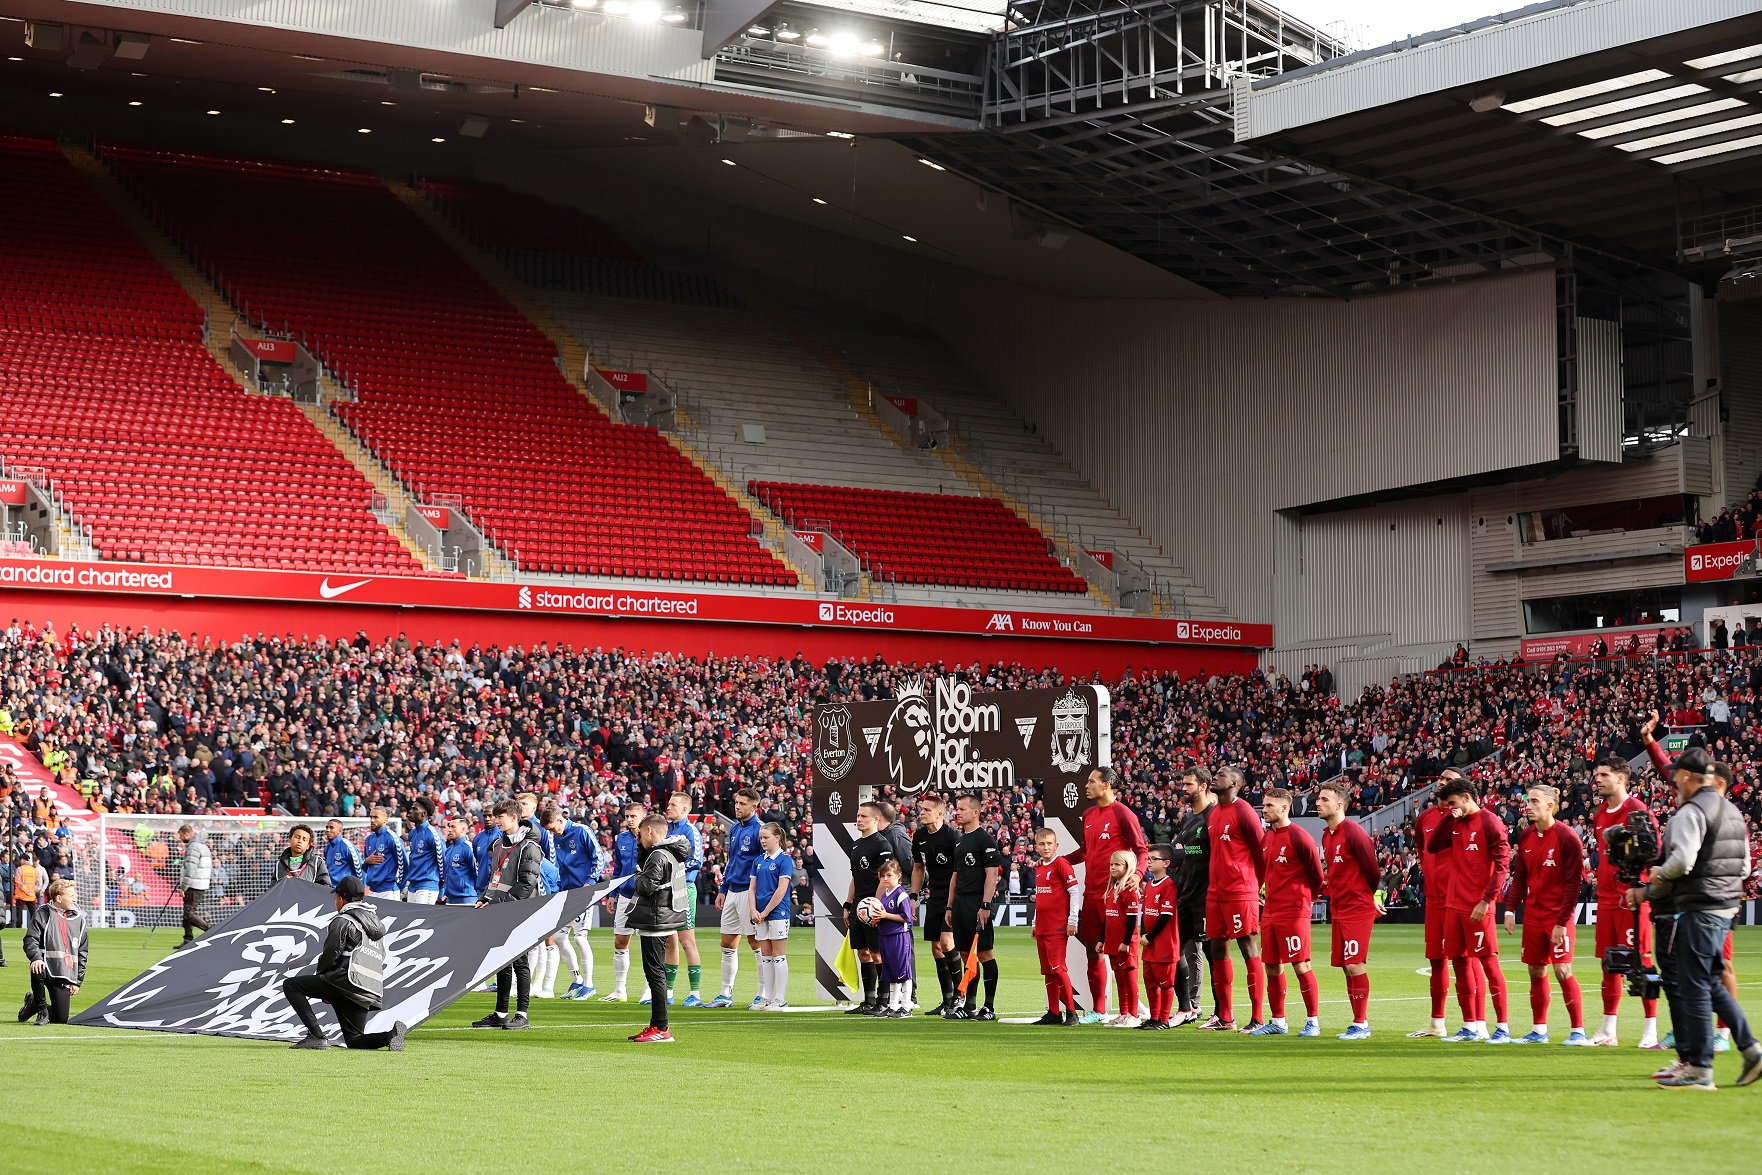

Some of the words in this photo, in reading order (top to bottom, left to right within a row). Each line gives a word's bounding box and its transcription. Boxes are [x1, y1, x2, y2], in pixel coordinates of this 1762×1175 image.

[257, 341, 275, 351] AU3
[612, 373, 628, 382] AU2
[421, 509, 441, 518] AM3
[77, 566, 173, 588] chartered
[536, 590, 613, 610] standard
[617, 594, 697, 614] chartered
[836, 605, 894, 625] Expedia
[985, 613, 1014, 631] AXA
[1021, 618, 1051, 631] Know
[1053, 619, 1072, 632] You
[1073, 620, 1092, 633] Can
[1192, 624, 1241, 641] Expedia
[936, 677, 970, 710] No
[936, 704, 999, 734] room
[1057, 721, 1083, 729] LIVERPOOL
[823, 748, 846, 759] Everton
[936, 732, 970, 764] for
[937, 751, 1013, 789] racism
[1233, 913, 1243, 930] 5
[1285, 935, 1302, 953] 10
[1344, 939, 1359, 956] 20
[1474, 931, 1485, 948] 7
